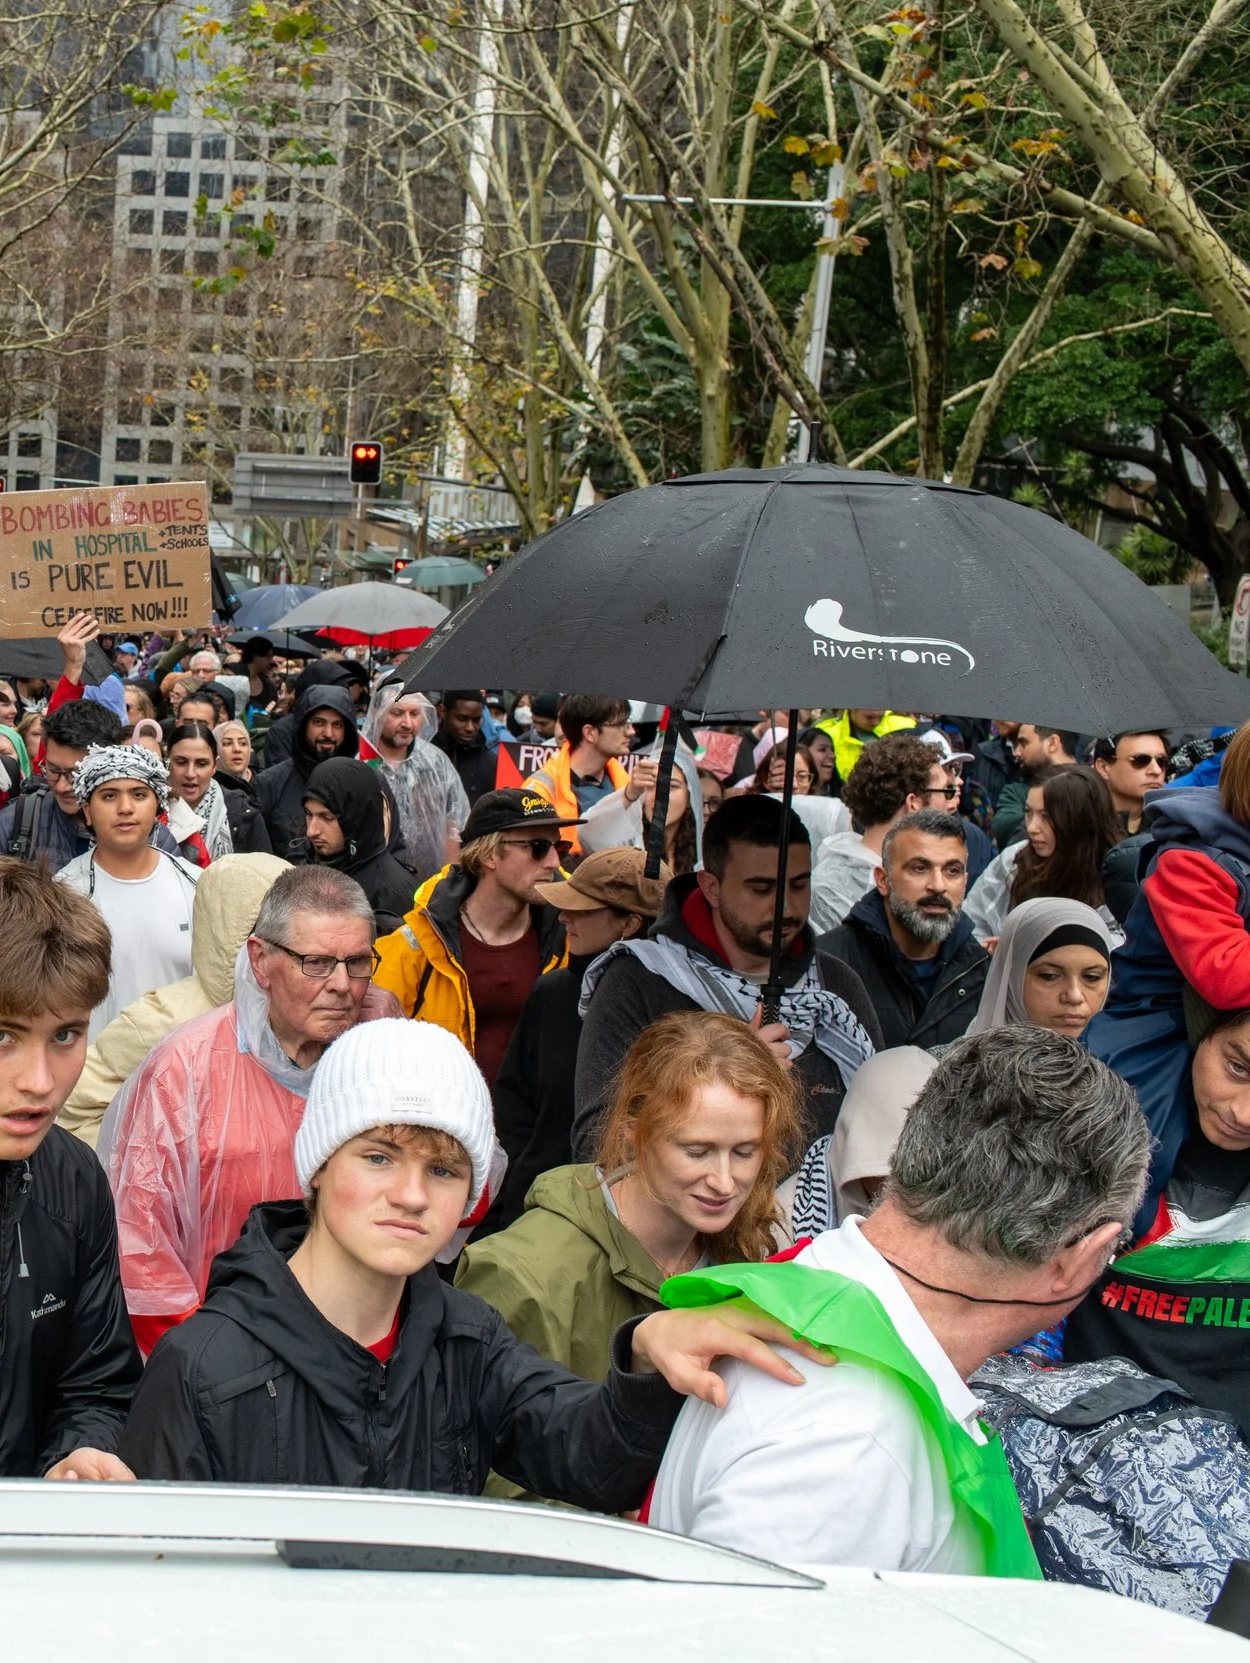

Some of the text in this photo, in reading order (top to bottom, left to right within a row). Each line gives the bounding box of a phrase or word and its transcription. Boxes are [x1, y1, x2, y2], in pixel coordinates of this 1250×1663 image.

[1, 498, 204, 535] BOMBING BABIES
[32, 532, 158, 561] IN HOSPITAL
[11, 559, 184, 592] IS PURE EVIL
[41, 605, 127, 628] CEAFIRE
[519, 745, 560, 772] FRO
